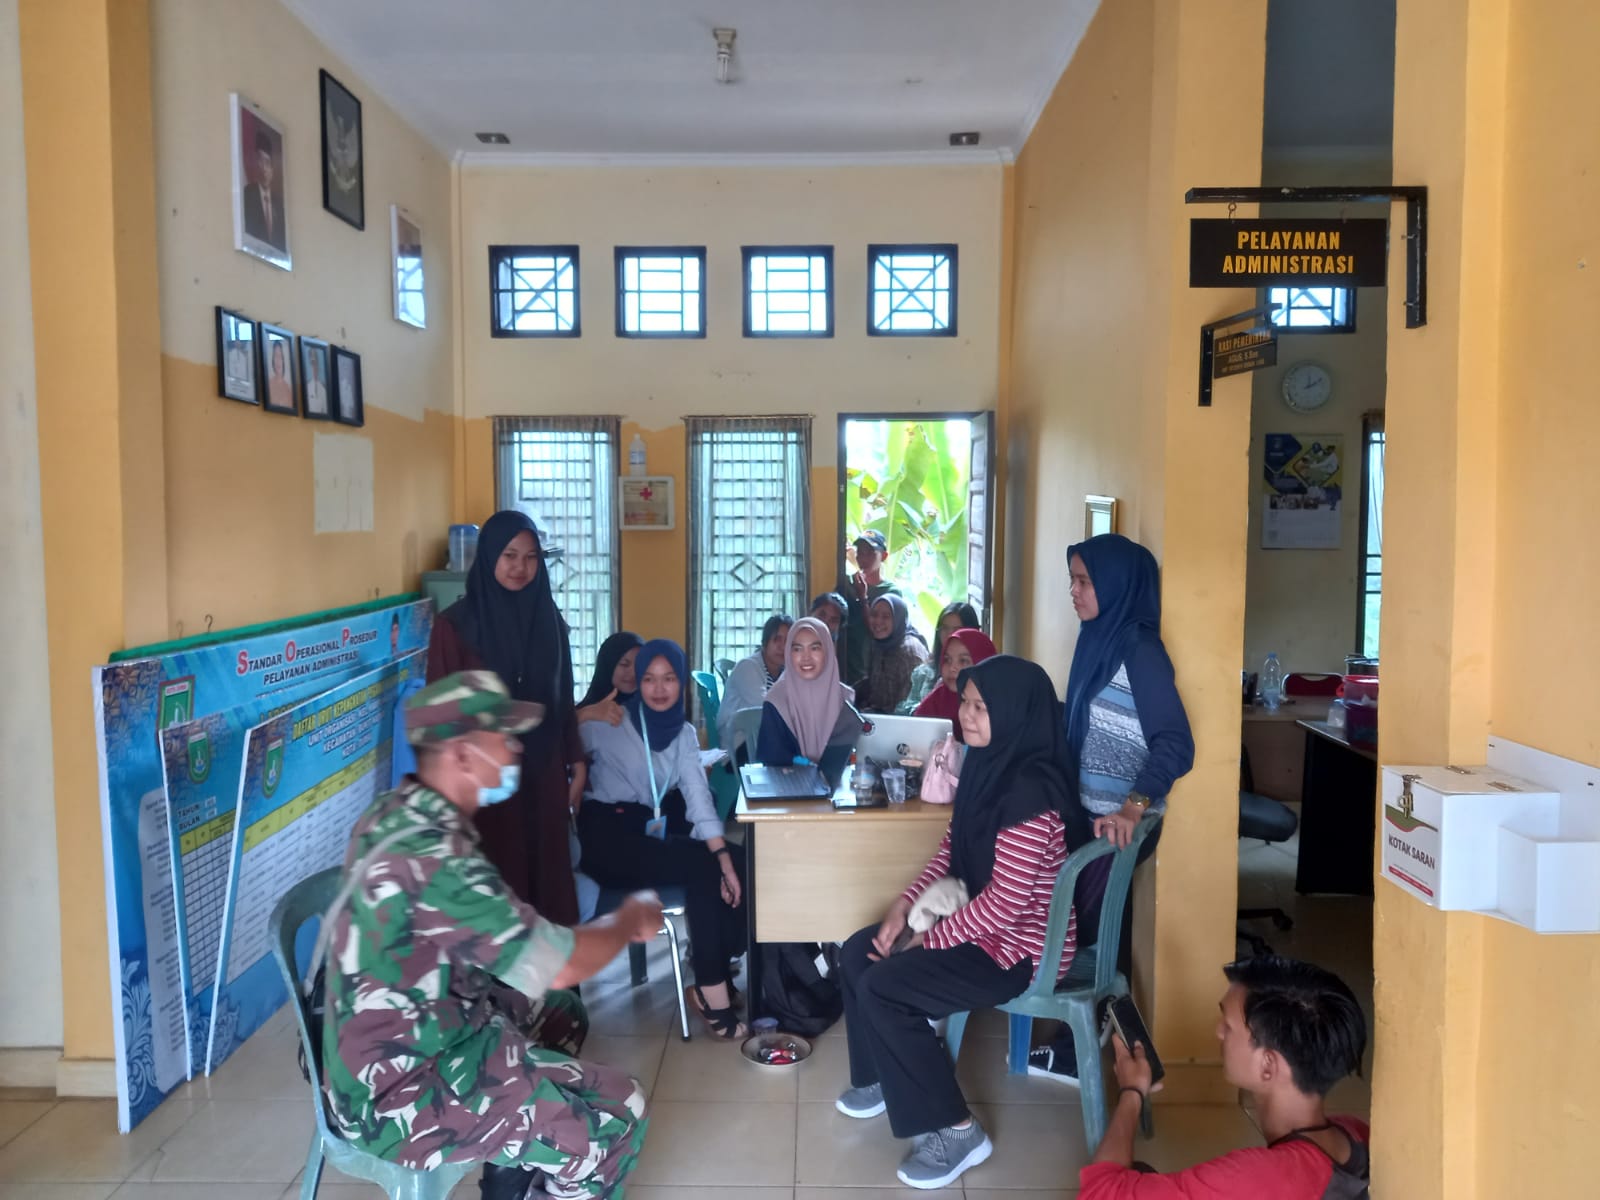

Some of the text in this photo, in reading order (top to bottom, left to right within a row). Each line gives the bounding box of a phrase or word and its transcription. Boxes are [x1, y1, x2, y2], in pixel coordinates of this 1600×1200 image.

[1237, 231, 1341, 250] PELAYANAN
[1222, 255, 1354, 274] ADMINISTRASI
[237, 628, 378, 675] STANDAR OPERASIONAL PROSEDUR
[263, 665, 311, 686] PELAYANAN
[312, 651, 359, 672] ADMINISTRASI
[179, 816, 201, 830] BULAN
[1388, 833, 1435, 870] KOTAK SARAN
